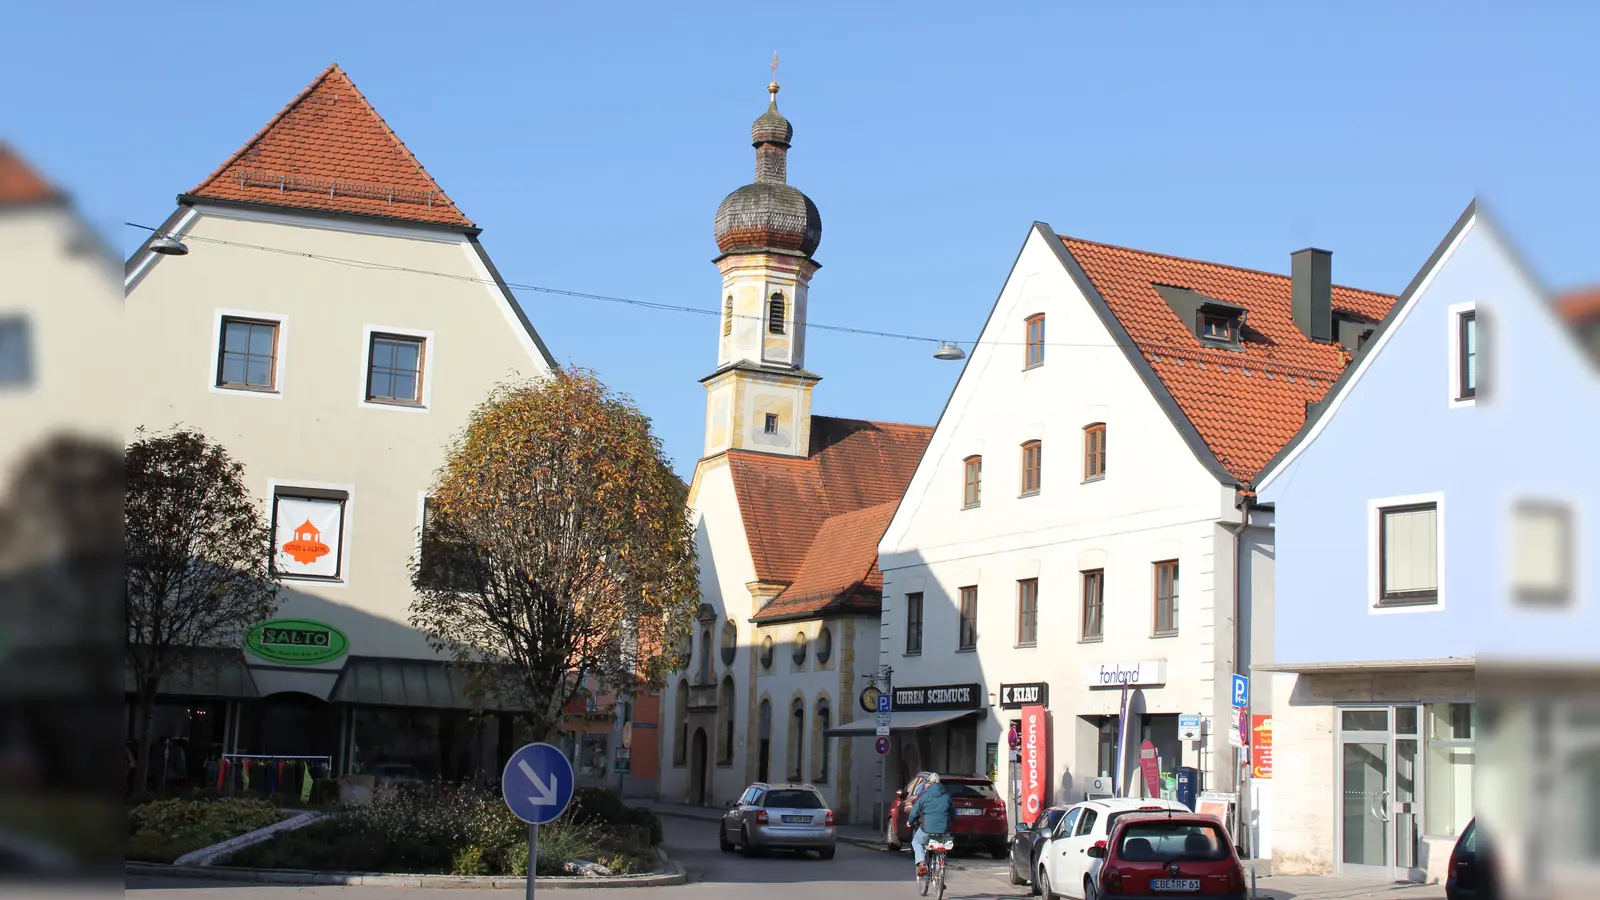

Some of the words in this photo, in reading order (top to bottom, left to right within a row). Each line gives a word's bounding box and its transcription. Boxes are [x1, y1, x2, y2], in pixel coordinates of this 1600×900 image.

[266, 630, 327, 645] SALTO
[1100, 662, 1140, 684] fonland
[896, 690, 924, 705] UHREN
[927, 687, 970, 704] SCHMUCK
[1013, 687, 1039, 702] KIAU
[1235, 679, 1245, 703] P
[1027, 714, 1038, 789] vodafone
[1154, 880, 1170, 889] EBE
[1176, 880, 1187, 889] RF
[1189, 880, 1200, 889] 61
